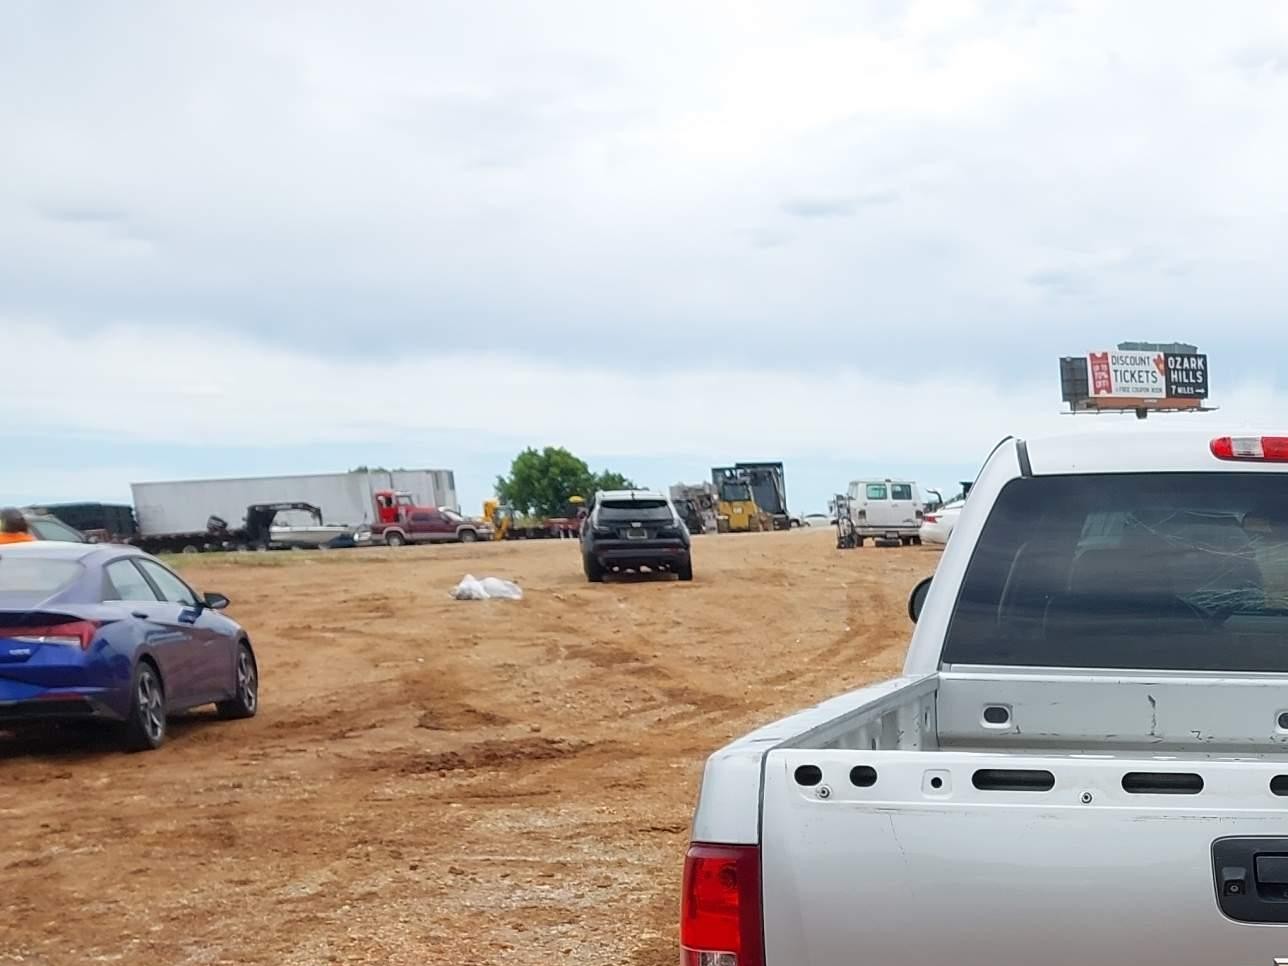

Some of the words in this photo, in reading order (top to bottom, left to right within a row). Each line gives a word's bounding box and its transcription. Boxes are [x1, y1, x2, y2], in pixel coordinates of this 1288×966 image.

[1112, 355, 1150, 366] DISCOUNT
[1167, 356, 1204, 370] OZARK
[1113, 369, 1158, 384] TICKETS
[1170, 369, 1203, 383] HILLS
[1171, 385, 1176, 395] 7
